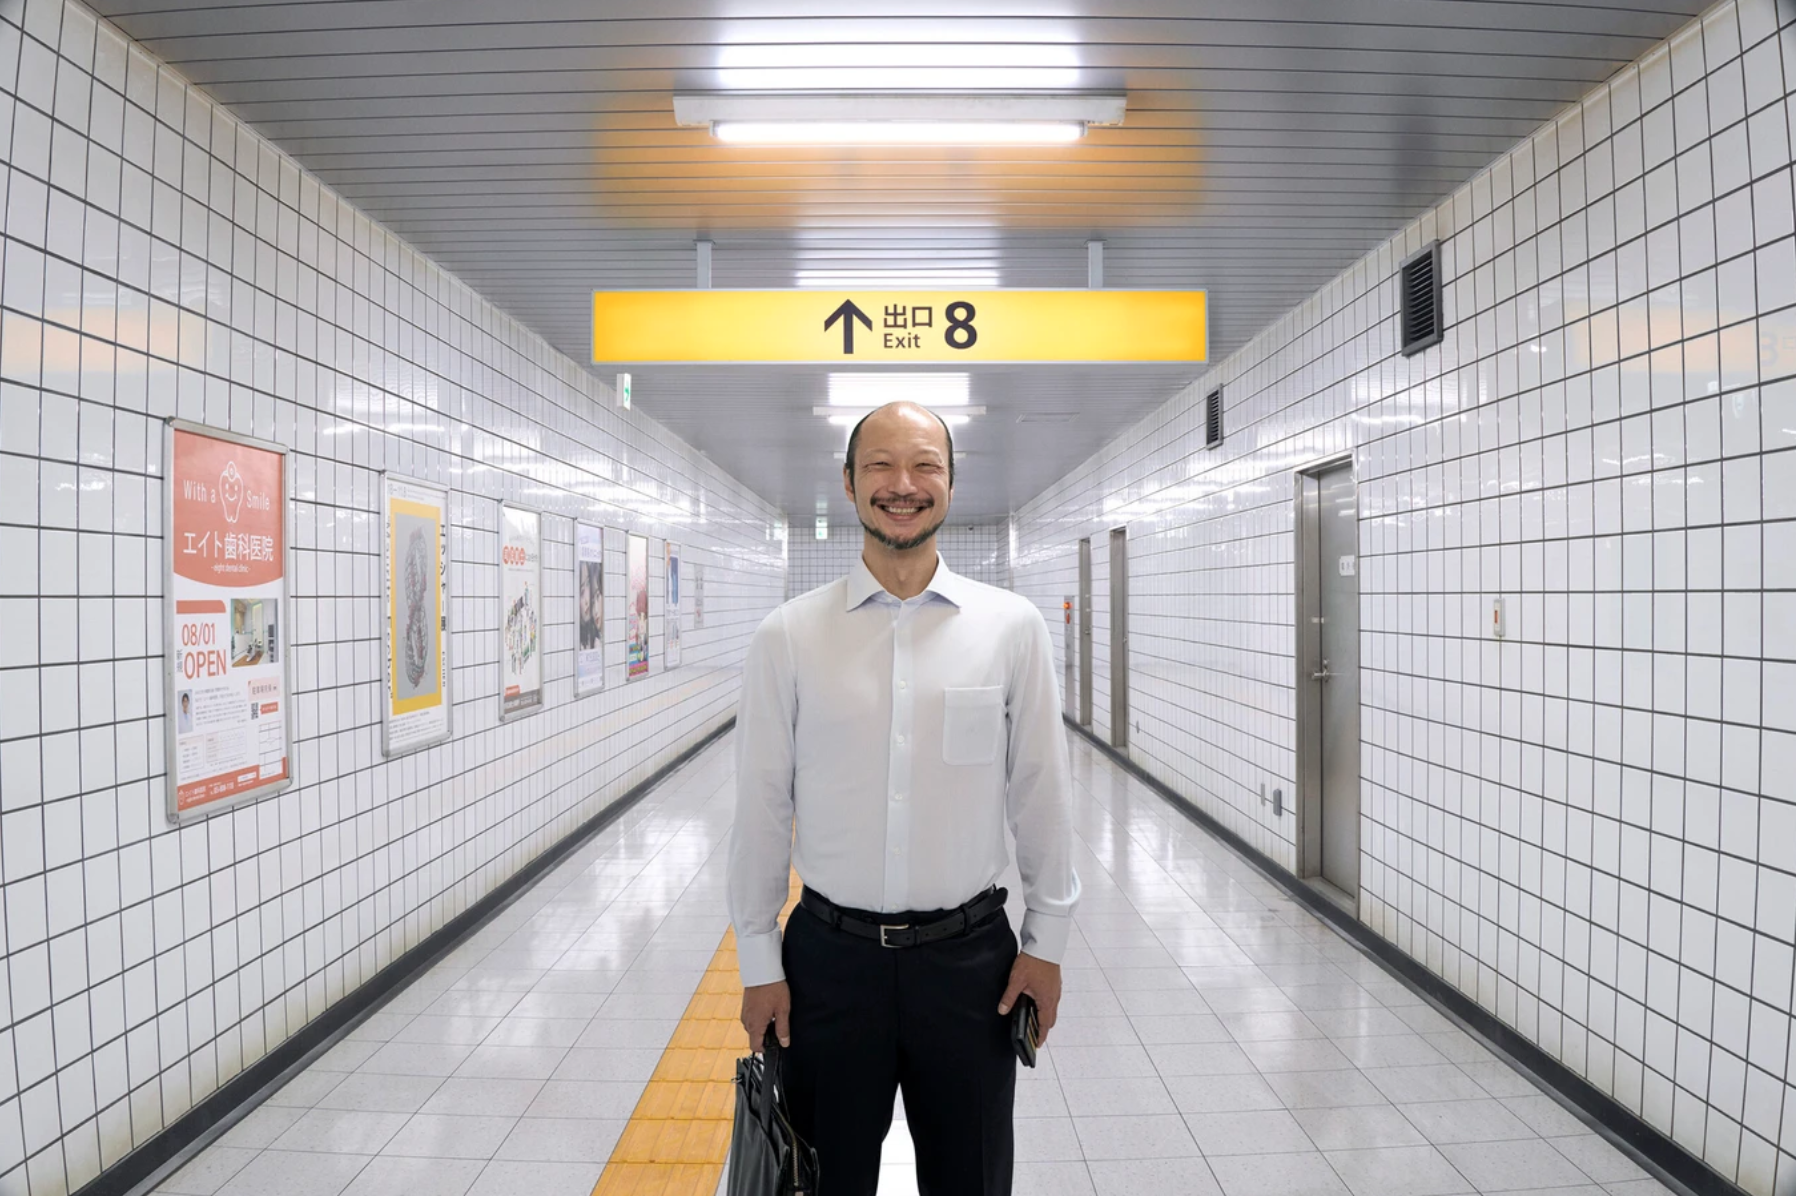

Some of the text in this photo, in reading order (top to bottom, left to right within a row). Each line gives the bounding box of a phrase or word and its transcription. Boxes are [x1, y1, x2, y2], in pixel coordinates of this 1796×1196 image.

[883, 303, 933, 330] 出口
[944, 300, 978, 350] 8
[883, 332, 921, 349] Exit
[183, 480, 270, 511] With a Smile
[183, 531, 274, 562] エイト歯科医院
[181, 622, 216, 648] 08/01
[184, 649, 227, 680] OPEN
